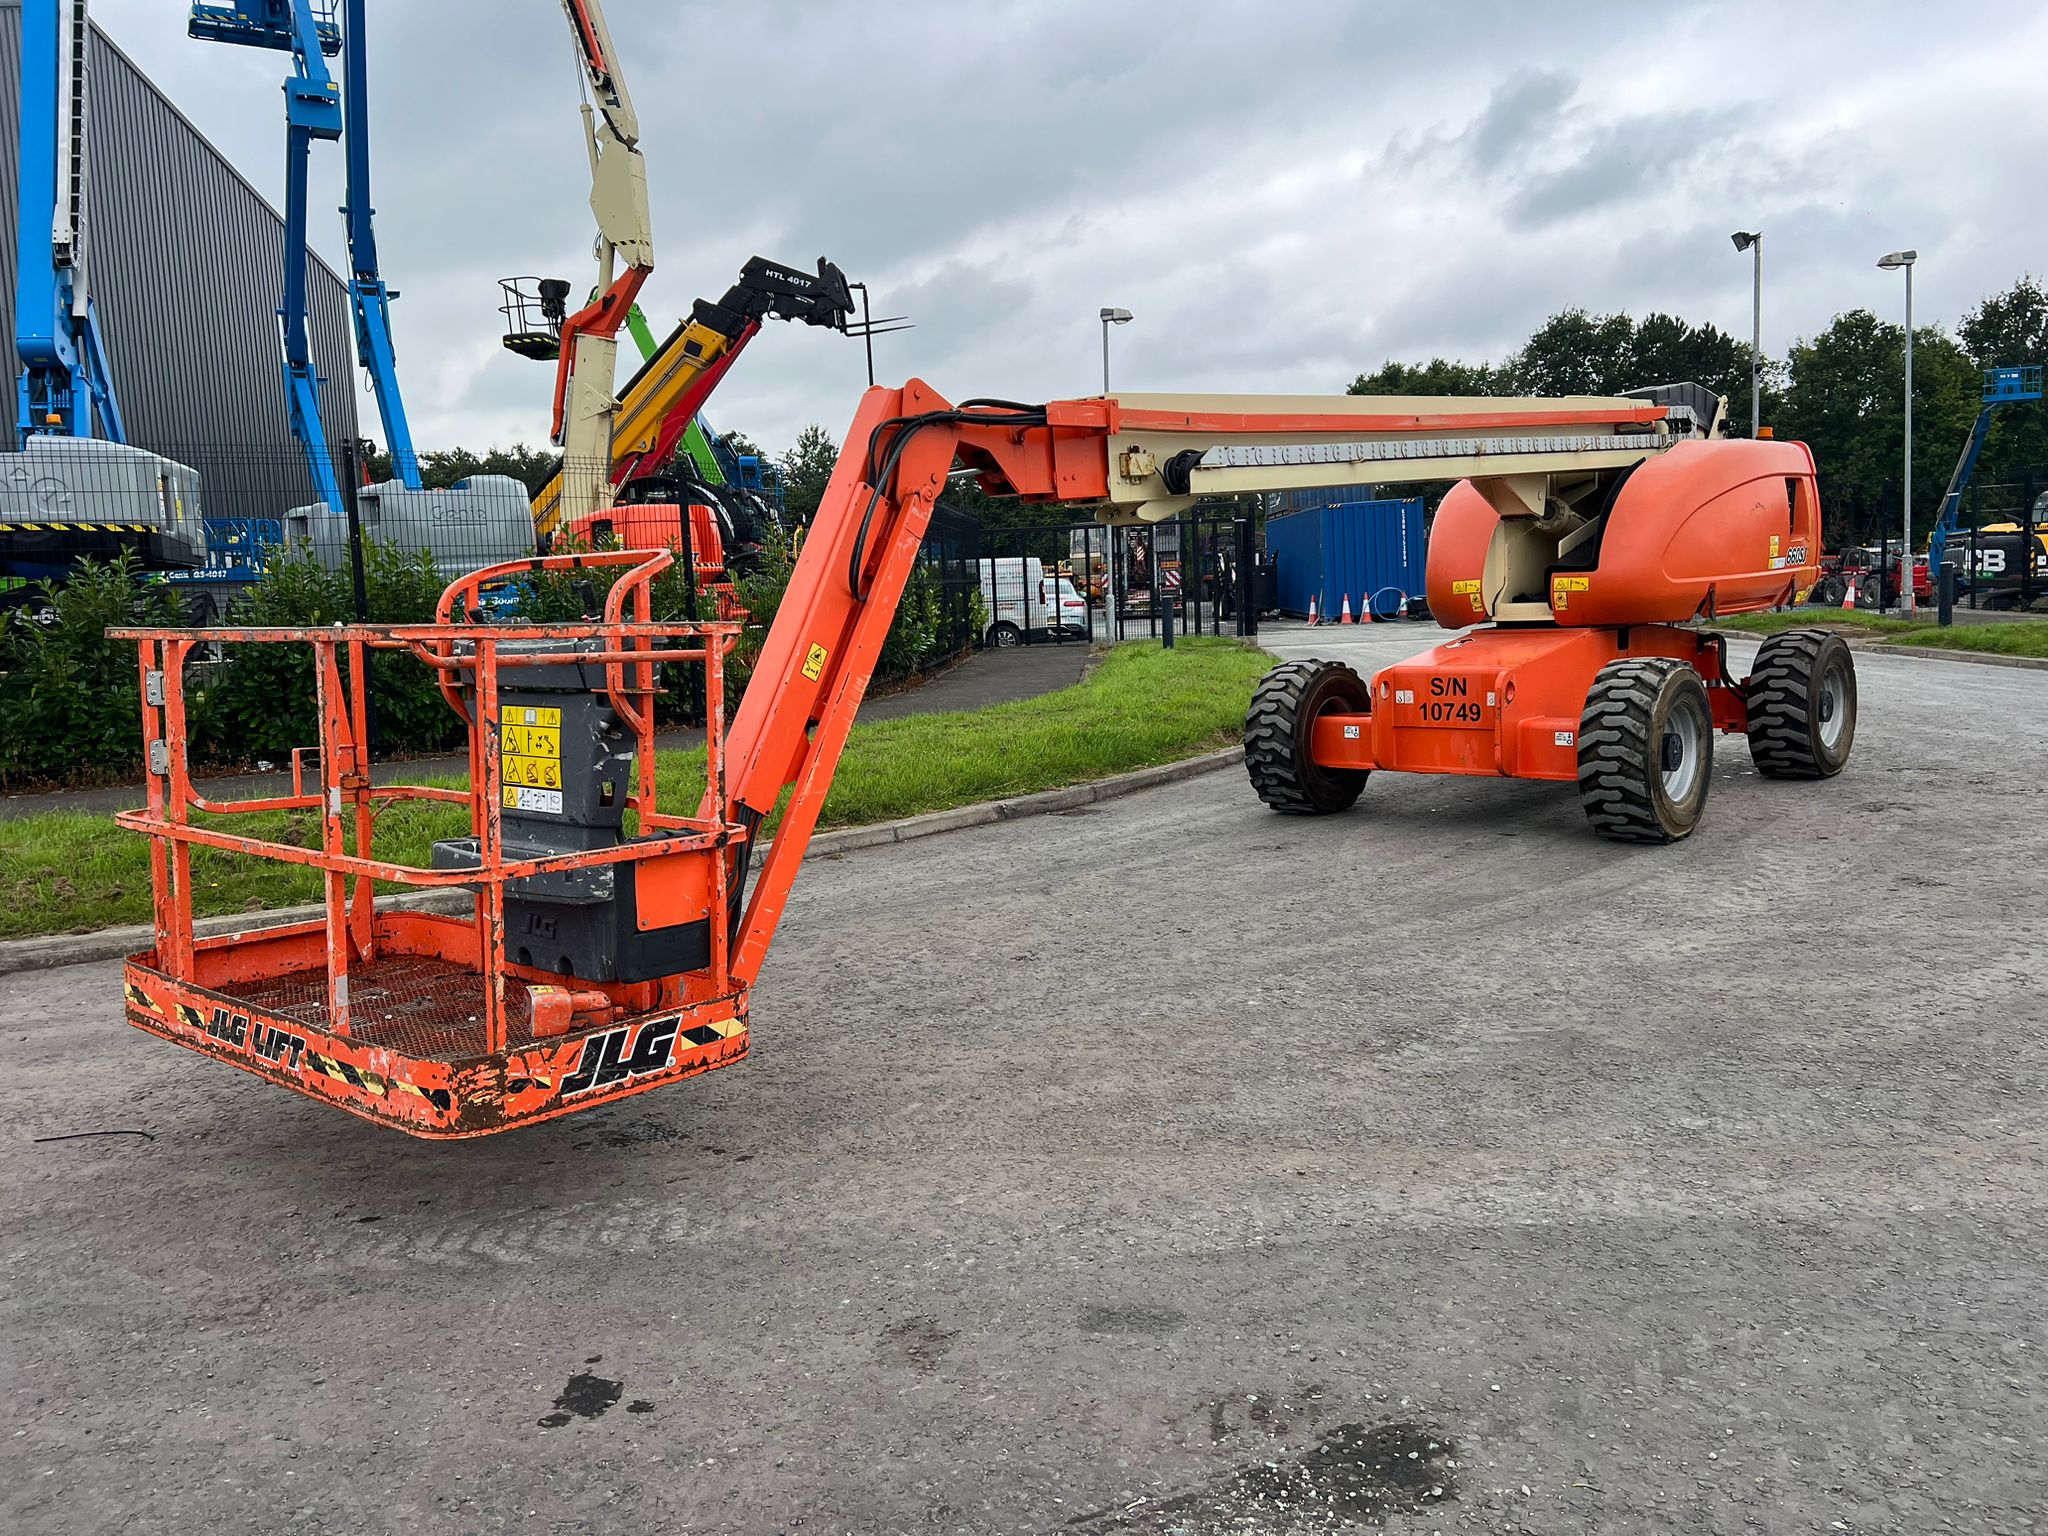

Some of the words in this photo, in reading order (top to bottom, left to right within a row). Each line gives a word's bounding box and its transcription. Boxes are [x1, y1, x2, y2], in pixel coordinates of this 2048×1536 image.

[765, 269, 785, 281] HTL
[787, 276, 812, 288] 4017
[1963, 549, 2006, 572] JCB
[1430, 677, 1467, 697] S/N
[1419, 702, 1481, 722] 10749
[521, 912, 558, 940] JLG
[206, 1007, 249, 1050] JLG
[250, 1021, 307, 1071] LIFT
[560, 1013, 683, 1099] JLG
